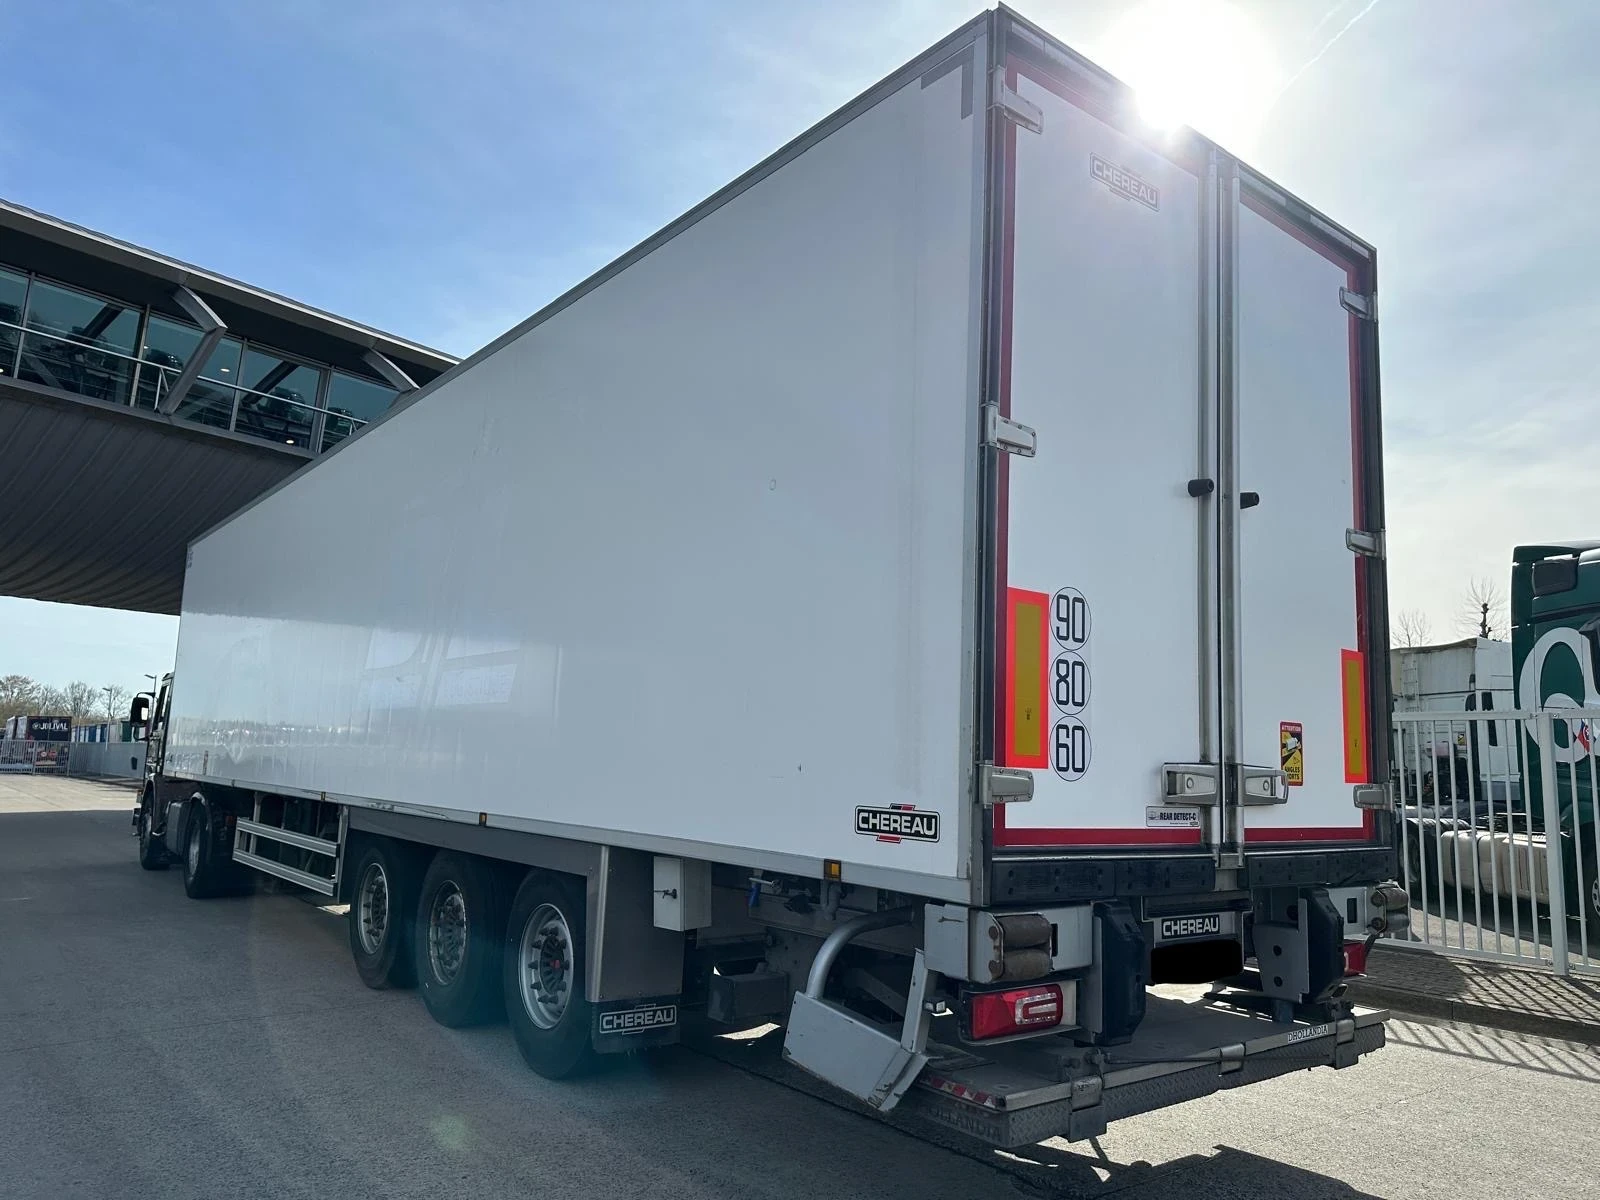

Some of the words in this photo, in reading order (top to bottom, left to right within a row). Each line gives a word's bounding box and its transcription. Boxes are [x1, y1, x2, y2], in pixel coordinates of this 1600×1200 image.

[1093, 159, 1157, 204] CHEREAU
[1056, 594, 1085, 643] 90
[1056, 658, 1085, 708] 80
[1056, 724, 1085, 773] 60
[858, 812, 936, 835] CHEREAU
[1162, 917, 1219, 936] CHEREAU
[602, 1008, 674, 1029] CHEREAU
